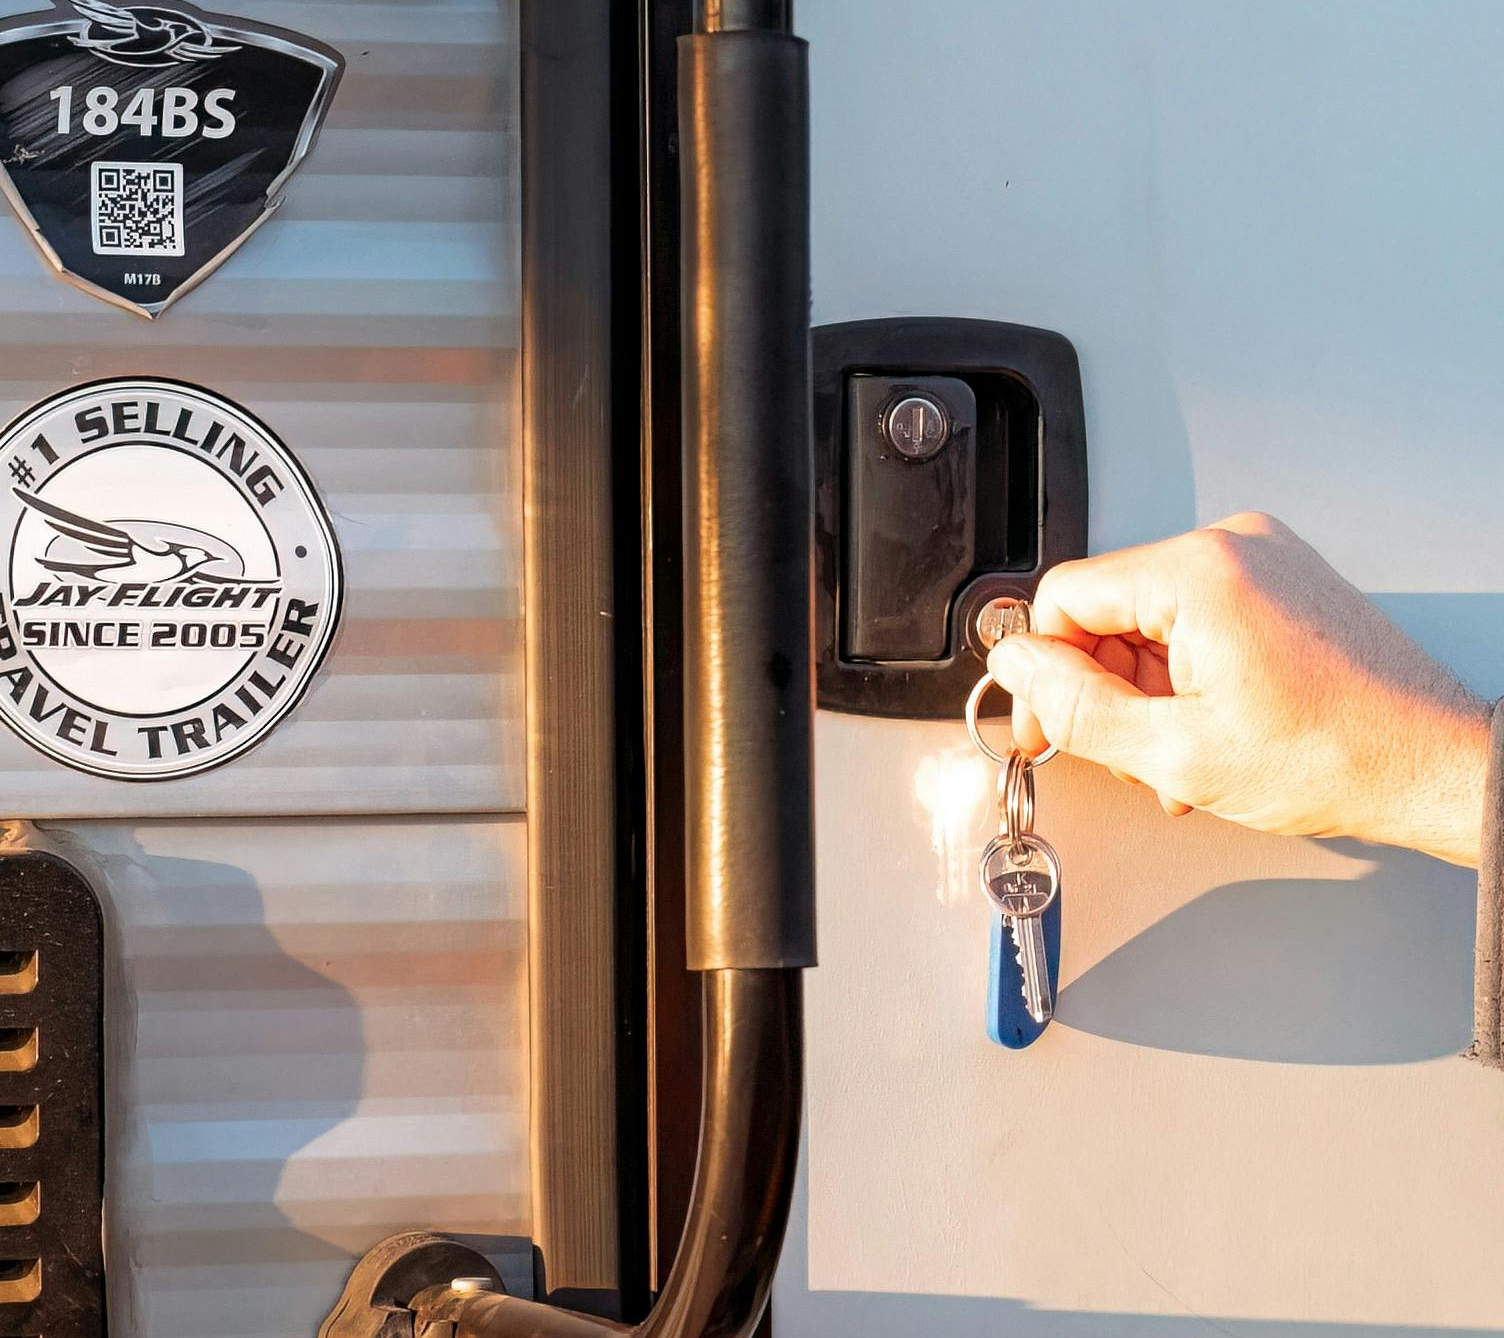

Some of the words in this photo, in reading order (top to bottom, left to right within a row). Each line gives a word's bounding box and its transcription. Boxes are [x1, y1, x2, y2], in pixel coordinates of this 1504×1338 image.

[49, 85, 237, 140] 184BS
[123, 273, 162, 286] M17B
[7, 433, 60, 489] #1
[74, 401, 285, 508] SELLING
[23, 621, 140, 647] SINCE
[152, 622, 266, 648] 2005
[137, 598, 320, 759] TRAILER
